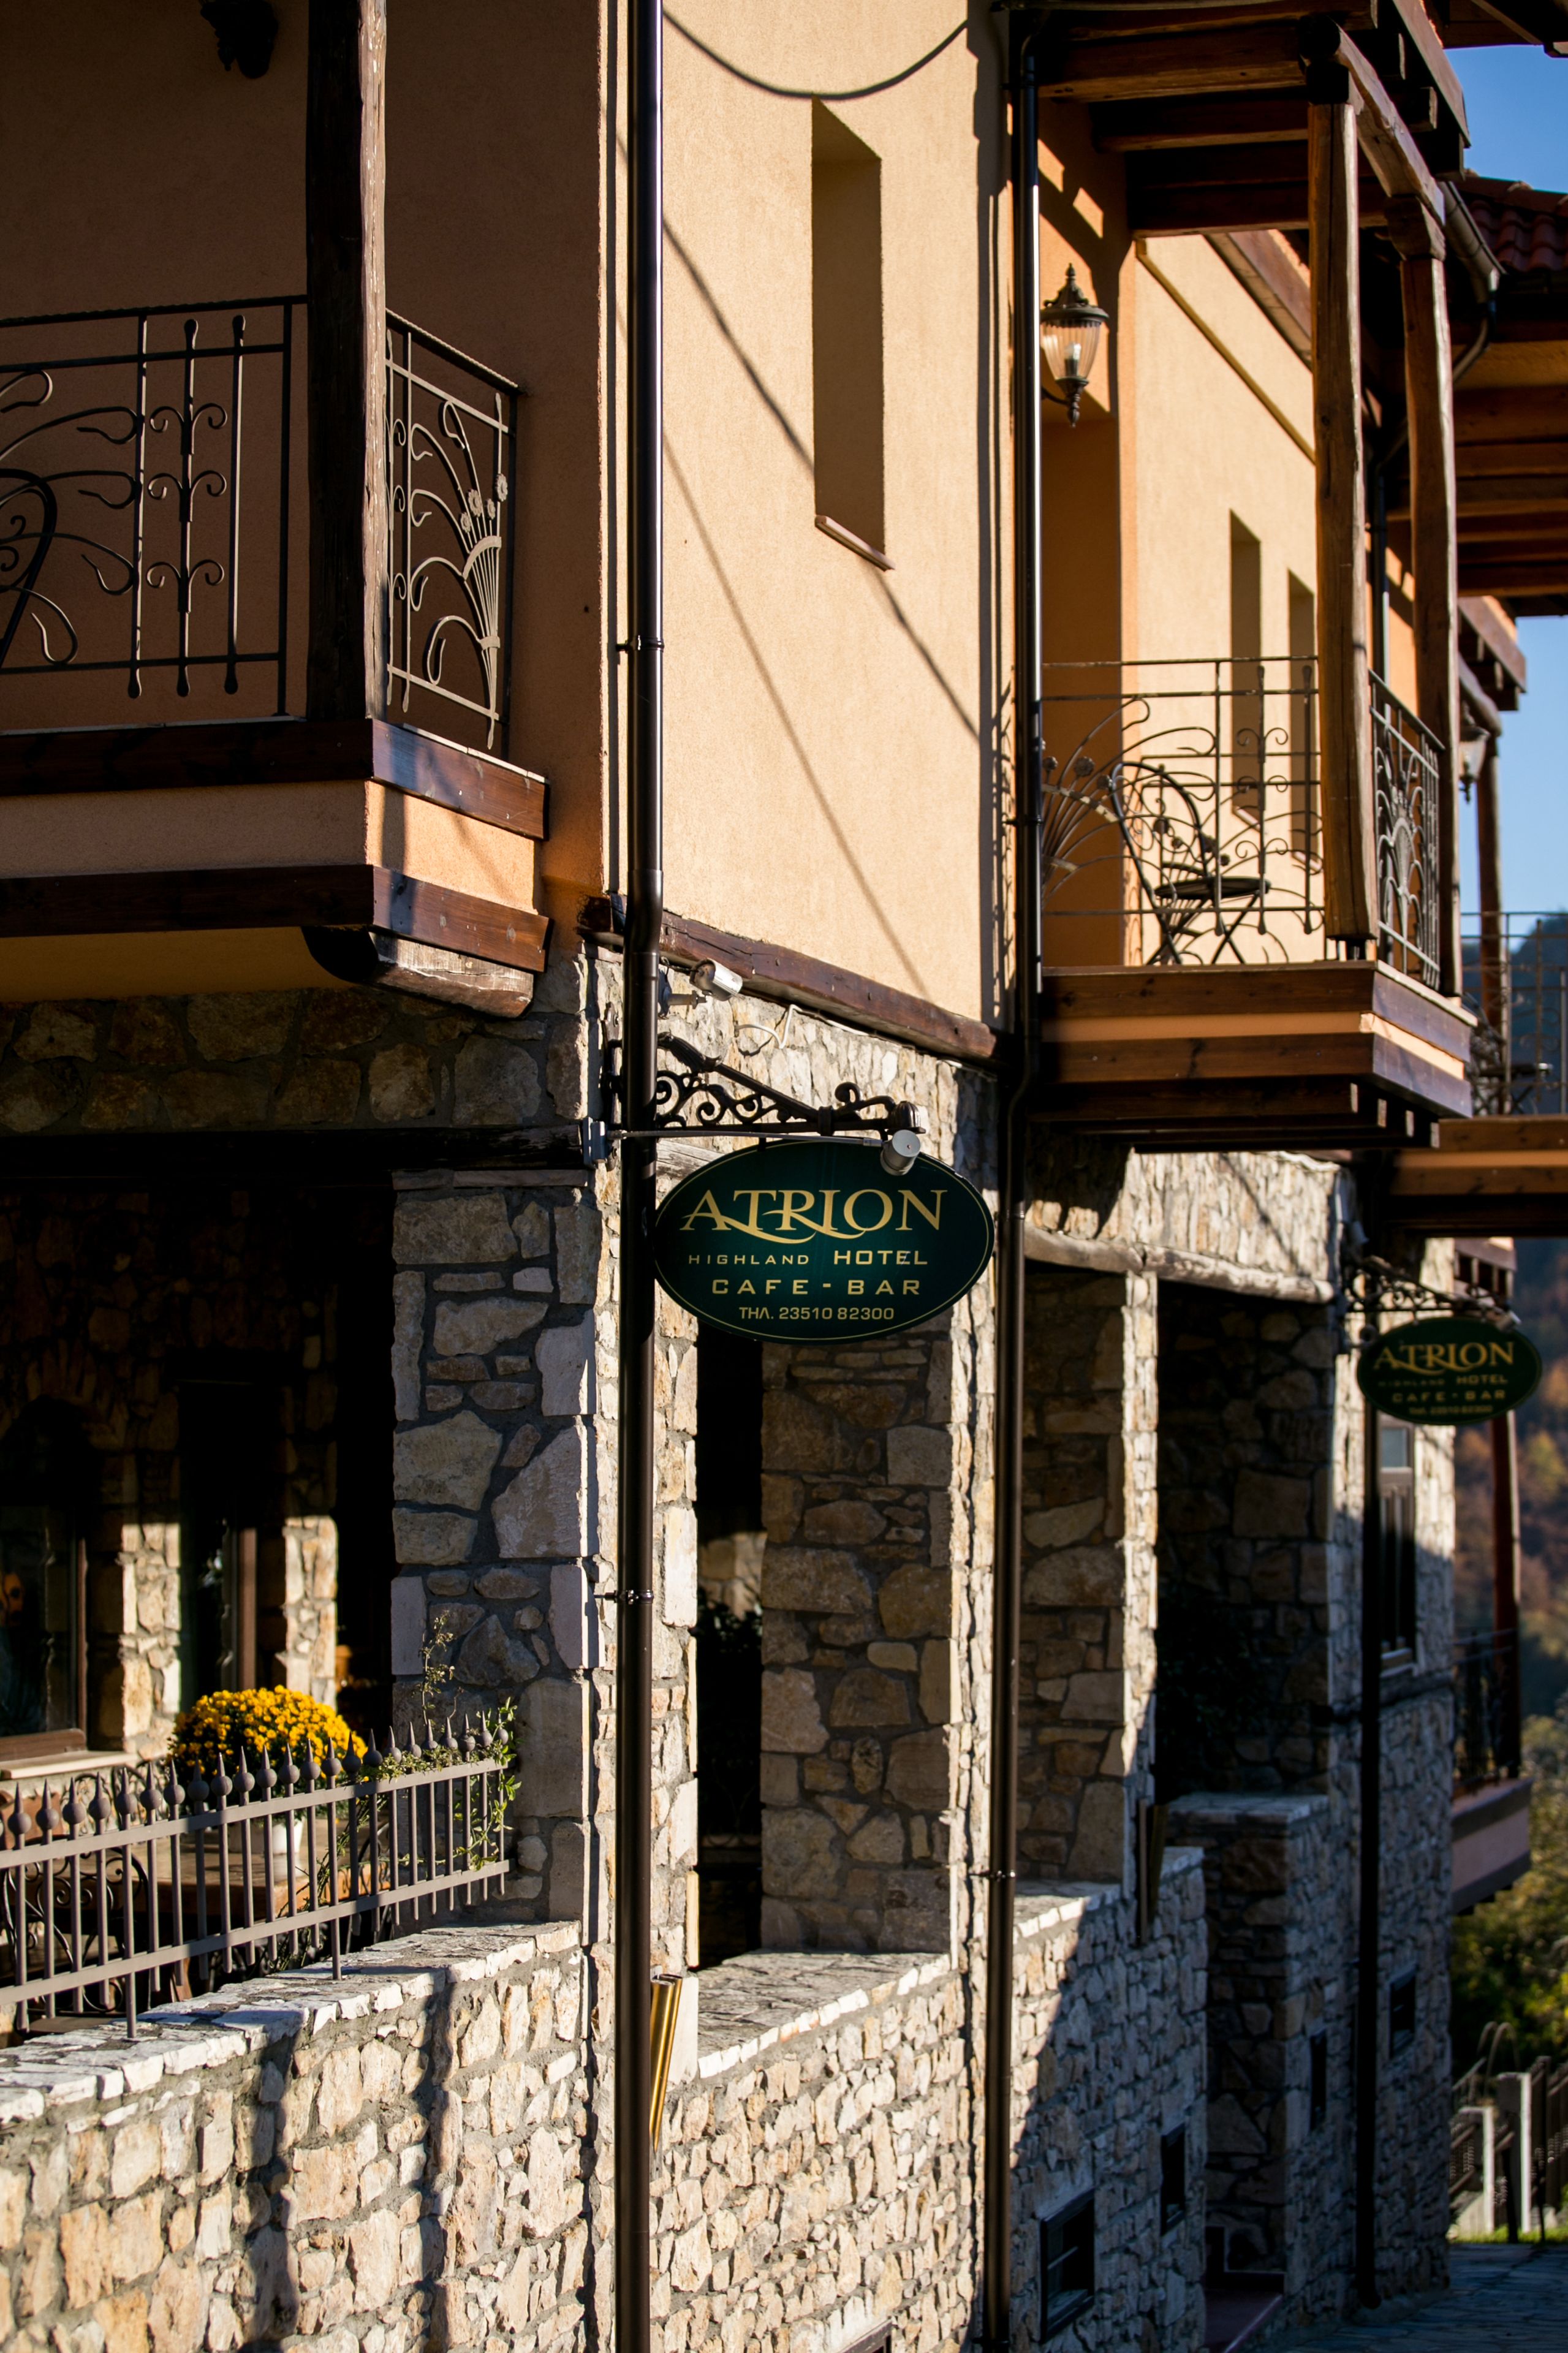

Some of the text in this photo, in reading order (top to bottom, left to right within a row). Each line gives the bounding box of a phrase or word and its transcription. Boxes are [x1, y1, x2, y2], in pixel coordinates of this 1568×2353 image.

[679, 1189, 948, 1244] ATRION
[688, 1250, 928, 1265] HIGHLAND HOTEL
[711, 1279, 809, 1295] CAFE
[847, 1279, 920, 1295] BAR
[778, 1306, 833, 1320] 23510
[836, 1307, 895, 1320] 82300
[1373, 1341, 1515, 1376] ATRION
[1456, 1374, 1509, 1385] HOTEL
[1392, 1391, 1446, 1403] CAFE
[1464, 1389, 1506, 1401] BAR
